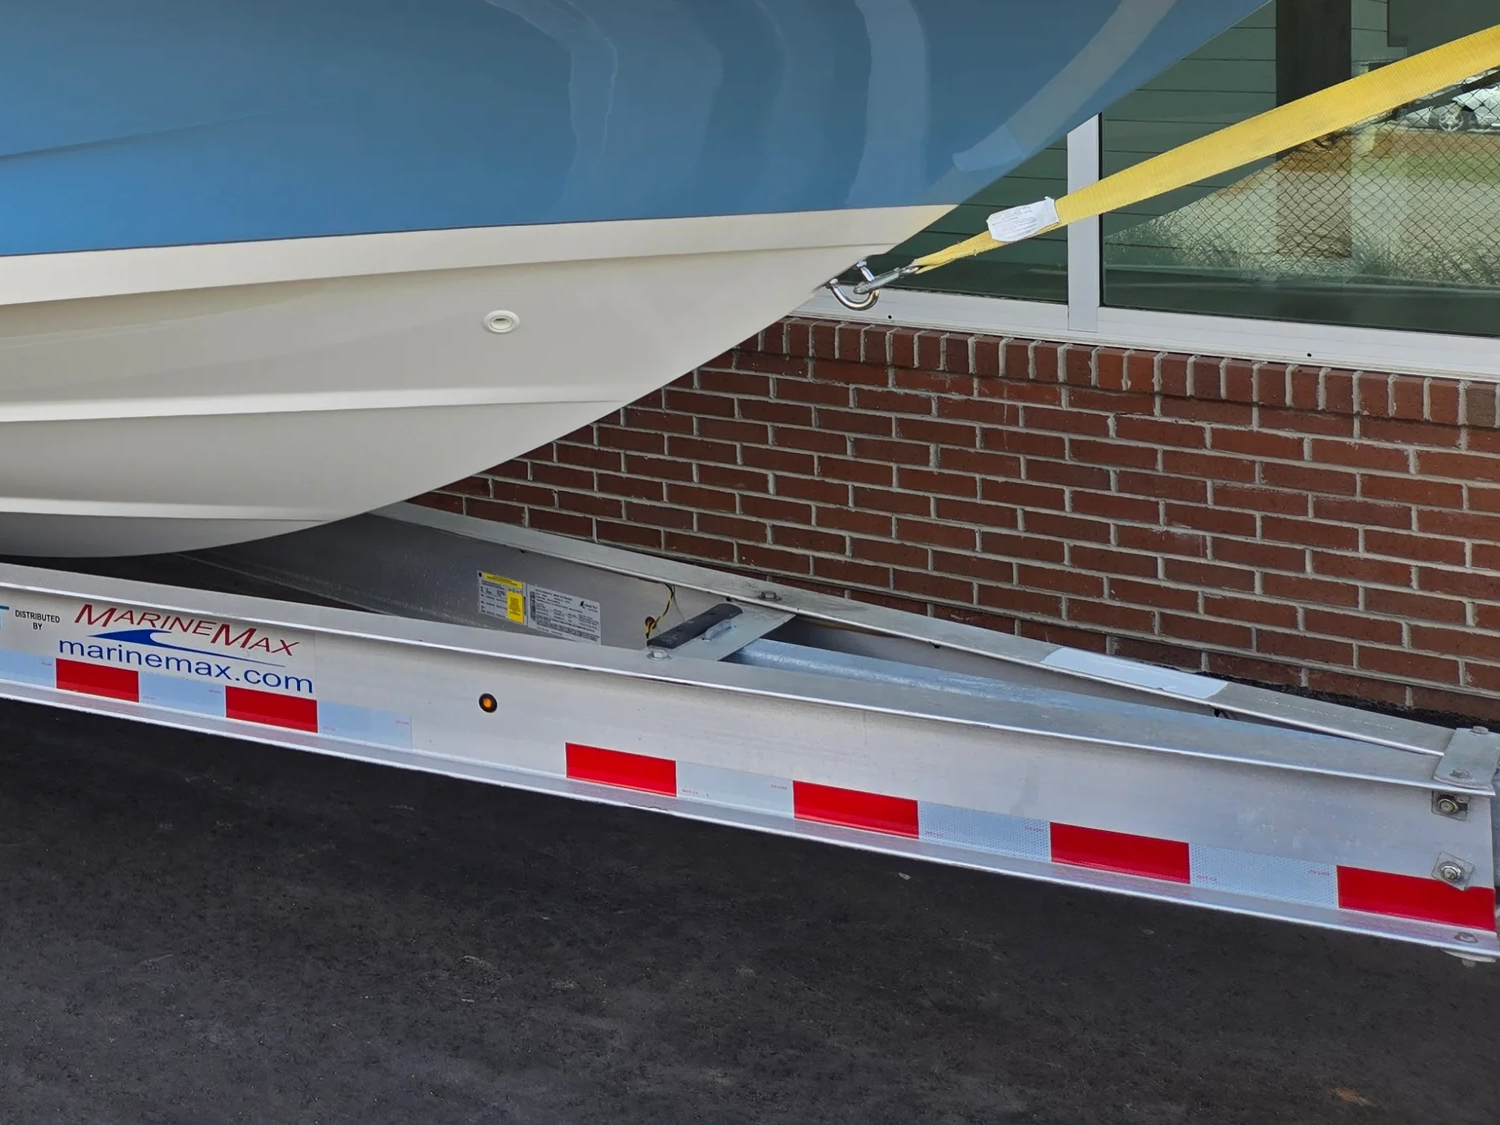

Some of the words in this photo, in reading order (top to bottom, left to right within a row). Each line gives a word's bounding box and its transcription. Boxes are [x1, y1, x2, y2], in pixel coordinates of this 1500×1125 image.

[15, 609, 60, 623] DISTRIBUTED
[32, 622, 43, 630] BY
[59, 638, 314, 694] marinemax.com
